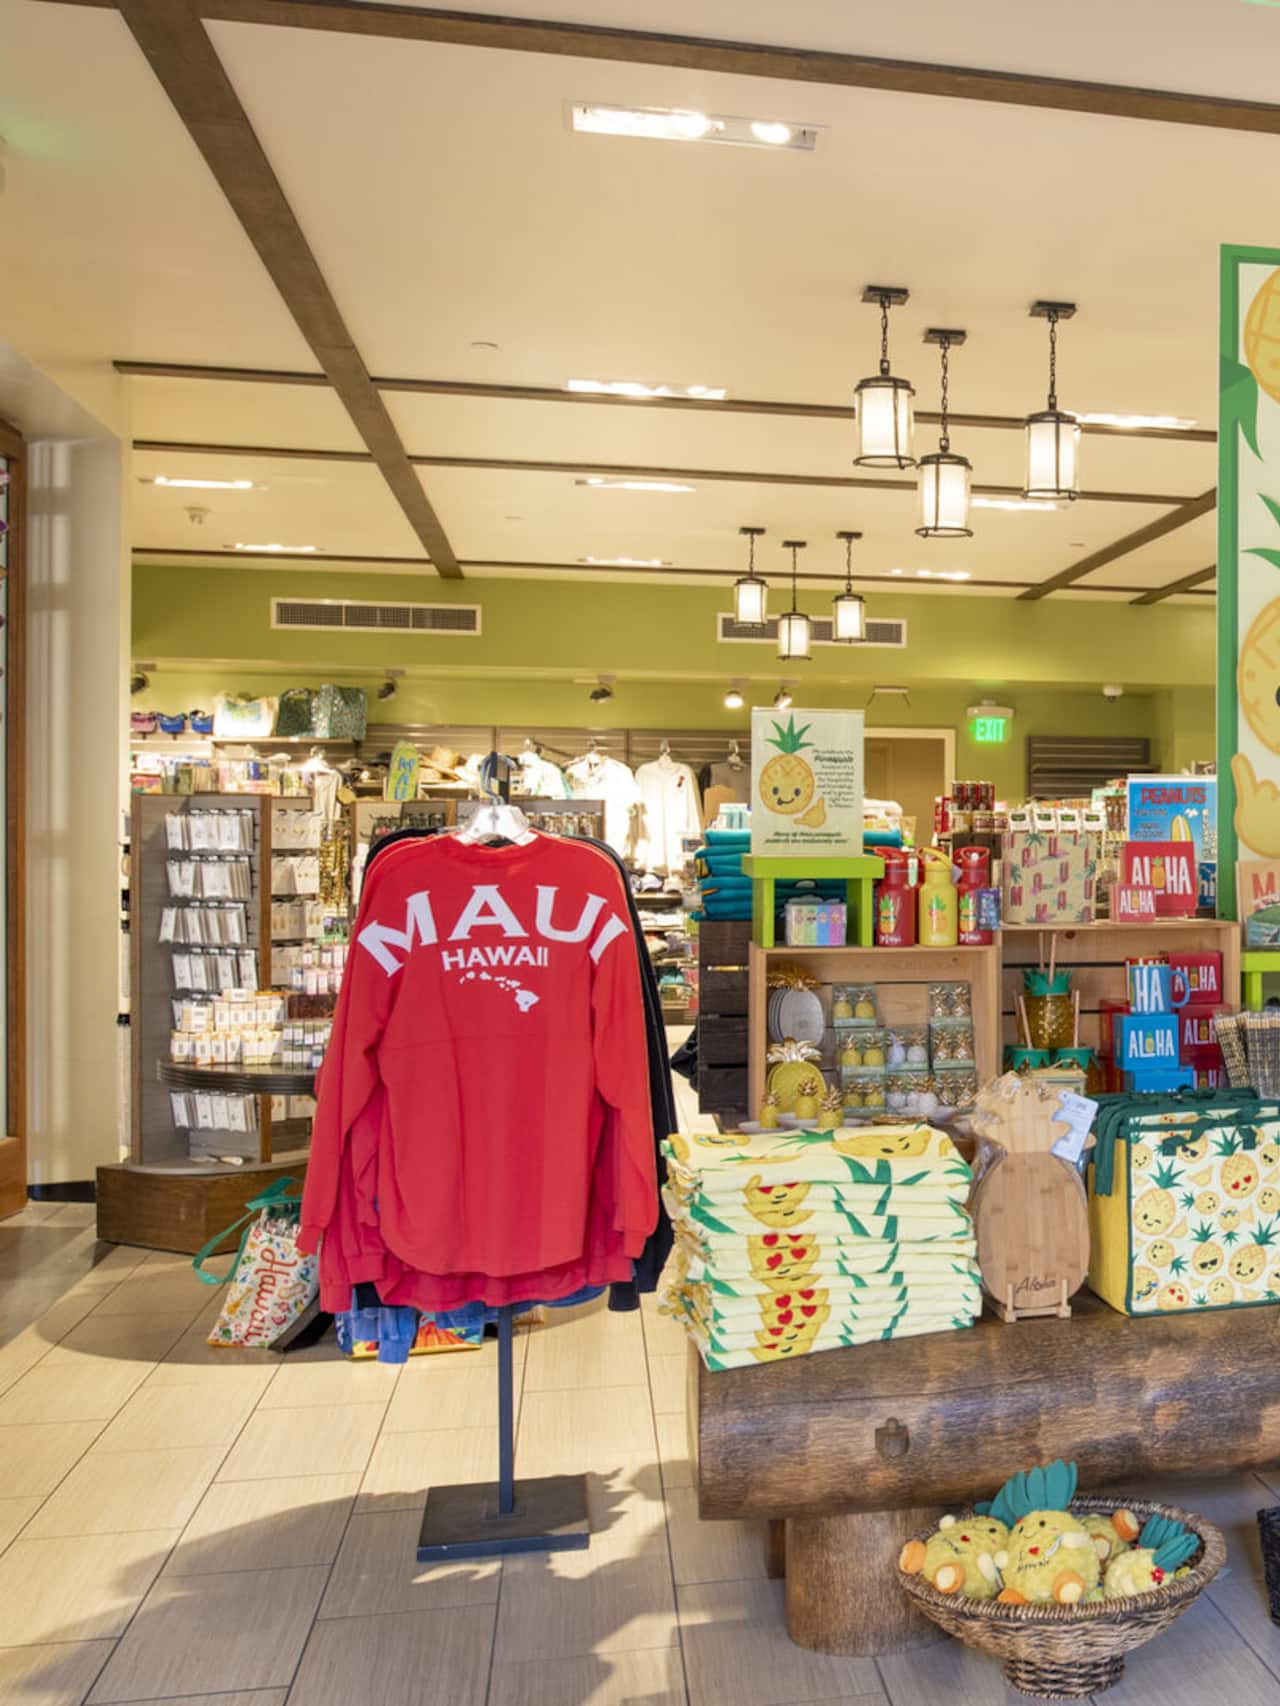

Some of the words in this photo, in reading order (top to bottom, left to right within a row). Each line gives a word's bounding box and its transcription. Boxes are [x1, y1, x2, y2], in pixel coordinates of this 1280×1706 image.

[975, 717, 1004, 742] EXIT
[1140, 787, 1207, 804] PEANUTS
[1131, 856, 1193, 896] ALOHA
[1119, 889, 1155, 914] ALOHA
[357, 884, 629, 978] MAUI
[440, 945, 549, 971] HAWAII
[1128, 1028, 1175, 1059] ALOHA
[243, 1247, 298, 1342] Hawaii
